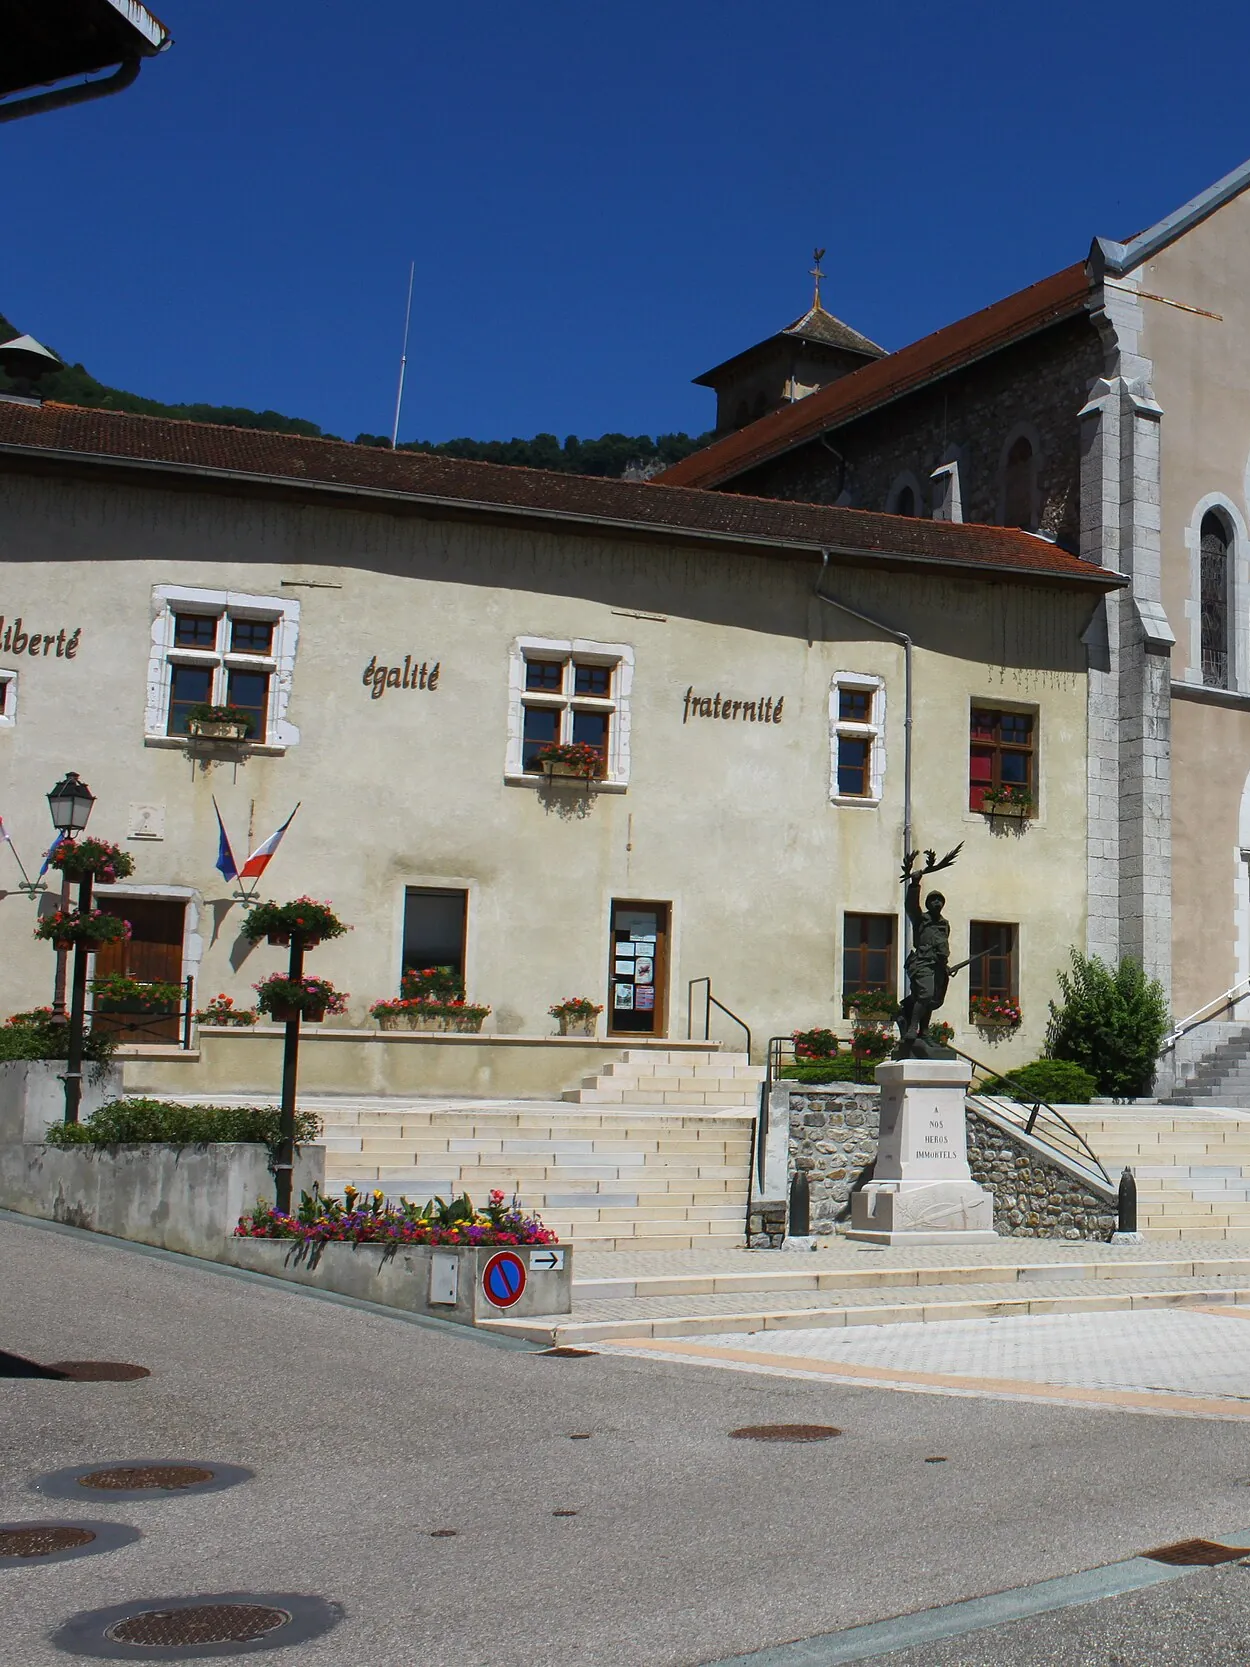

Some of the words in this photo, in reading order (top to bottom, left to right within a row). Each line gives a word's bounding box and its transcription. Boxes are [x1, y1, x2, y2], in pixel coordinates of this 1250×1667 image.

[362, 654, 441, 700] égalité
[683, 685, 785, 725] fraternité
[929, 1120, 943, 1128] NOS
[916, 1150, 957, 1158] IMMORTELS
